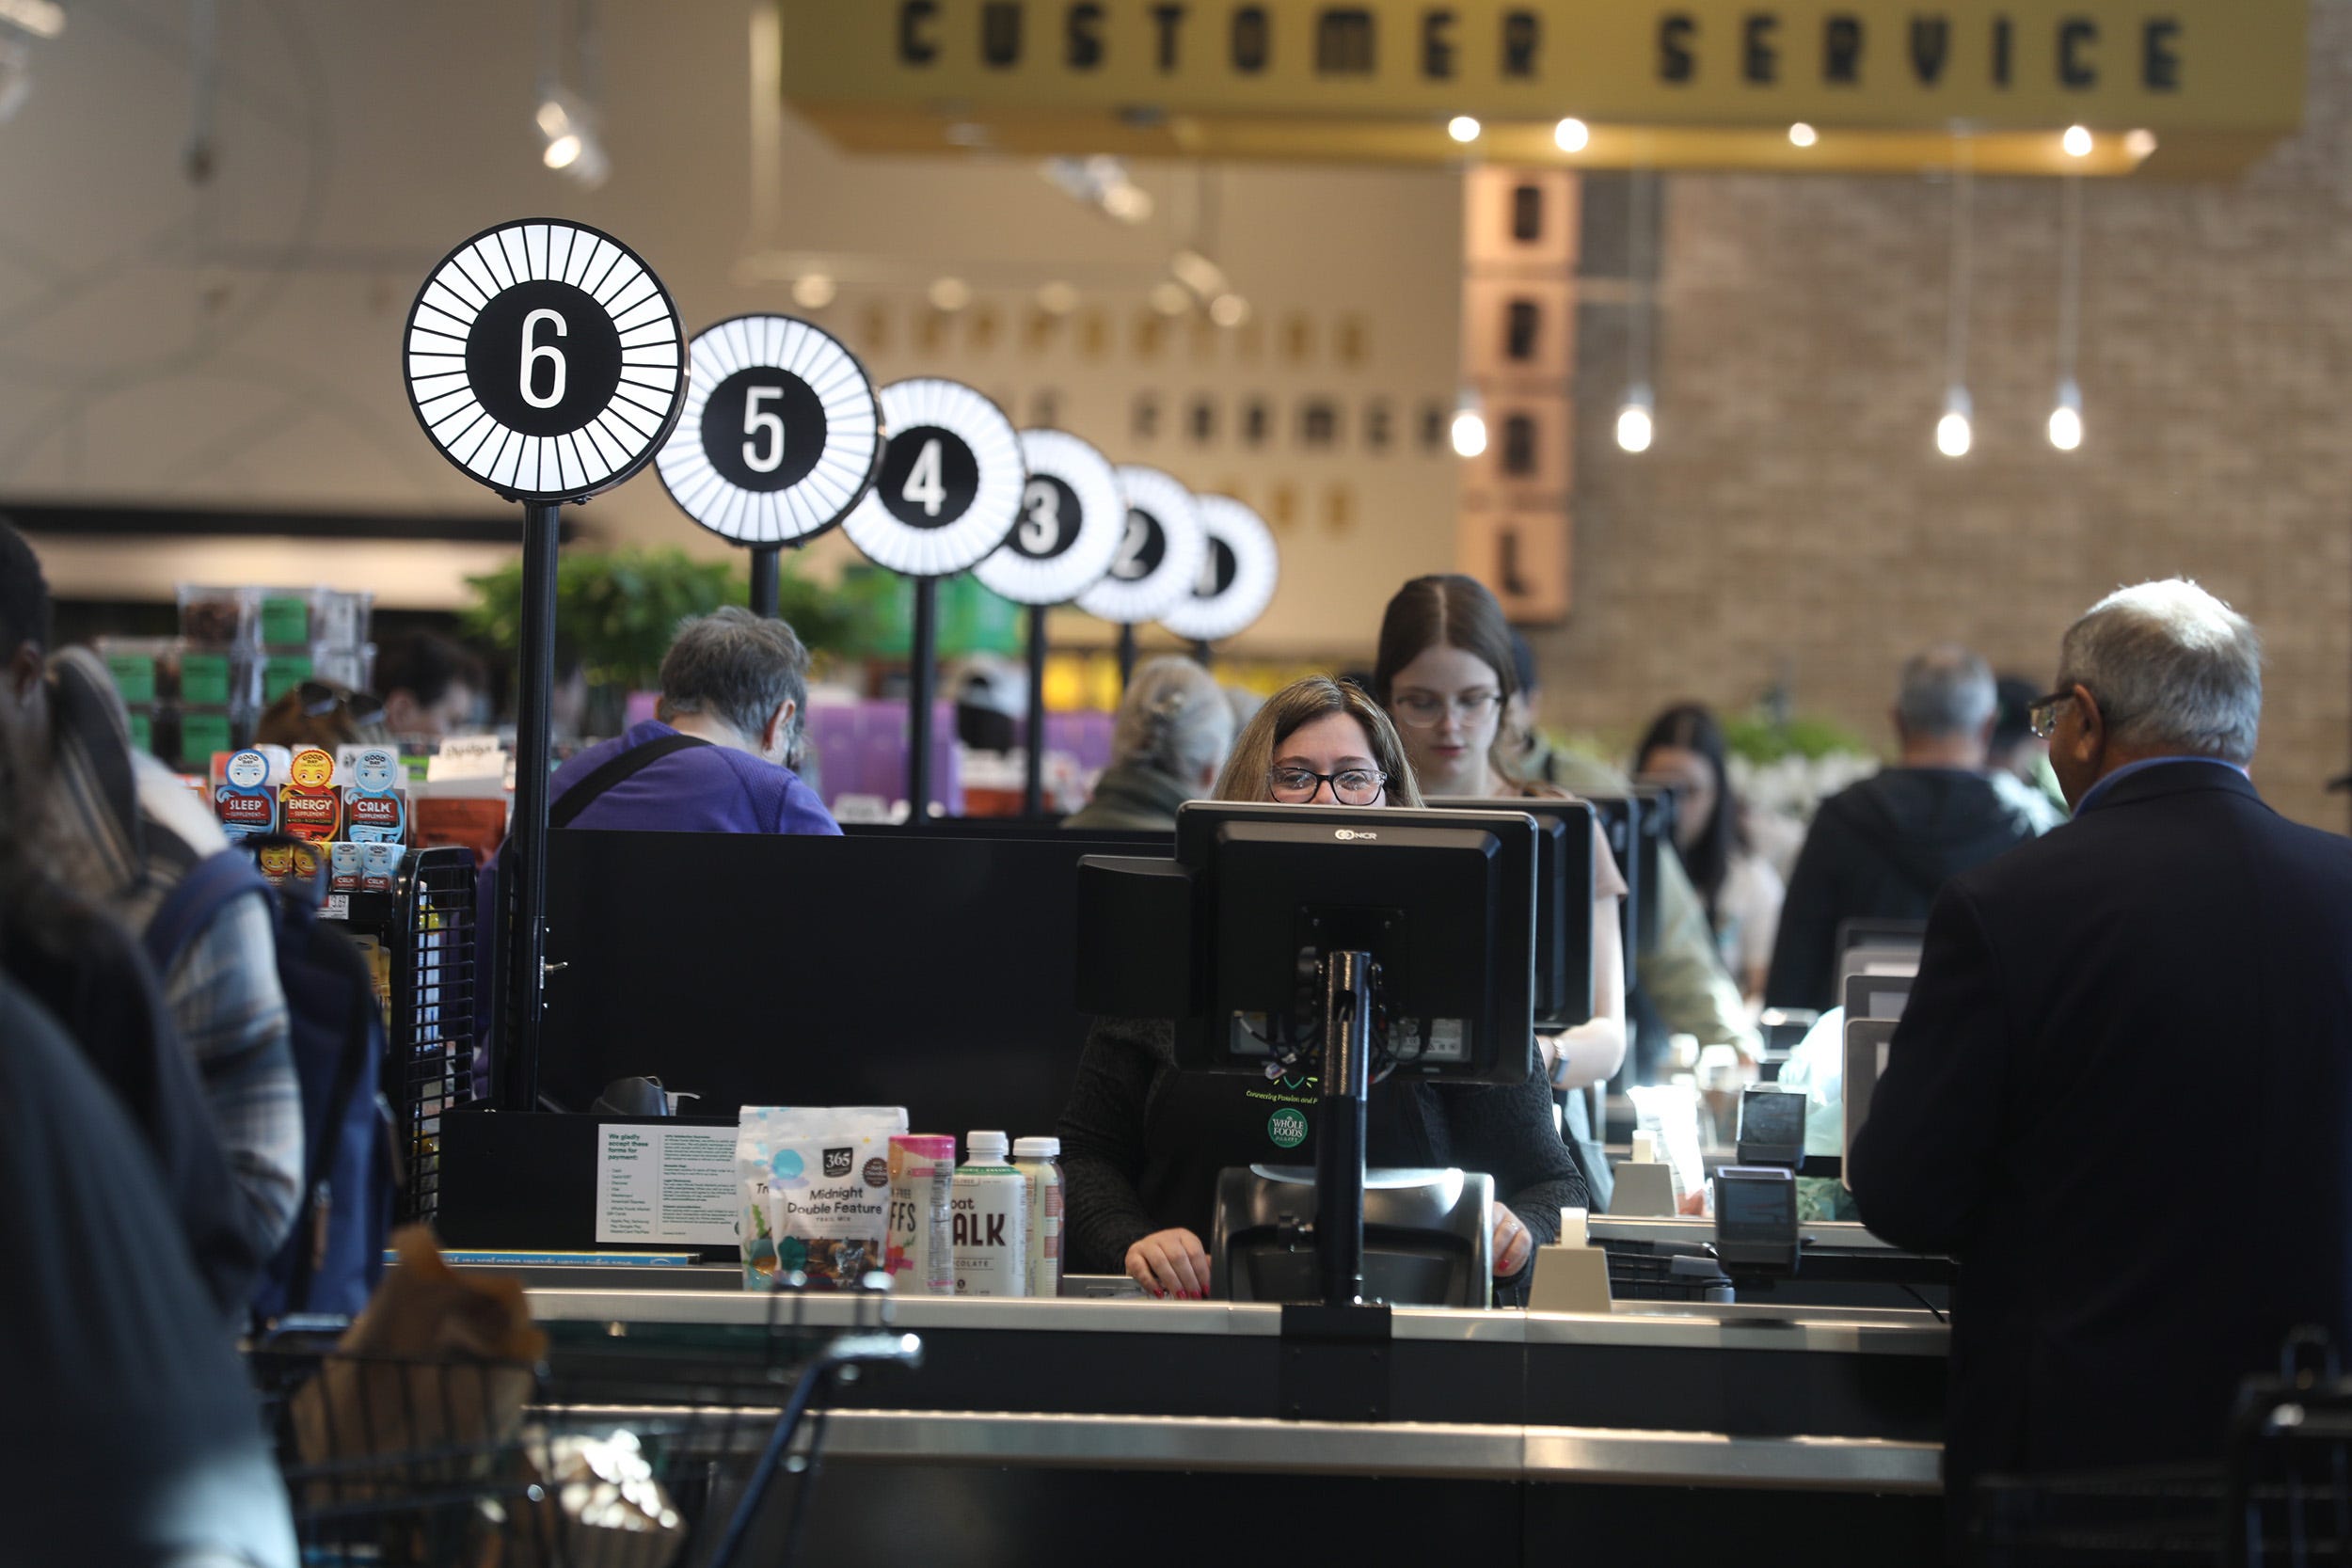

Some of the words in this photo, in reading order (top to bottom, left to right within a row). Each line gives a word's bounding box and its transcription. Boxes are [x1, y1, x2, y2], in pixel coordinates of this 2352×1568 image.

[896, 0, 1541, 82] CUSTOMER
[1657, 15, 2183, 91] SERVICE
[519, 309, 568, 409] 6
[742, 386, 786, 472] 5
[902, 438, 946, 516] 4
[1019, 481, 1060, 555] 3
[1115, 515, 1149, 578] 2
[1193, 539, 1218, 595] 1
[230, 800, 262, 810] SLEEP
[289, 799, 333, 811] ENERGY
[357, 801, 390, 813] CALM
[1246, 1090, 1277, 1102] Connecting
[1278, 1094, 1300, 1102] Passion
[1273, 1118, 1305, 1130] WHOLE
[1273, 1127, 1303, 1137] FOODS
[825, 1151, 851, 1168] 365
[809, 1187, 864, 1201] Midnight
[787, 1202, 832, 1215] Double
[834, 1202, 882, 1214] Feature
[950, 1197, 975, 1210] oat
